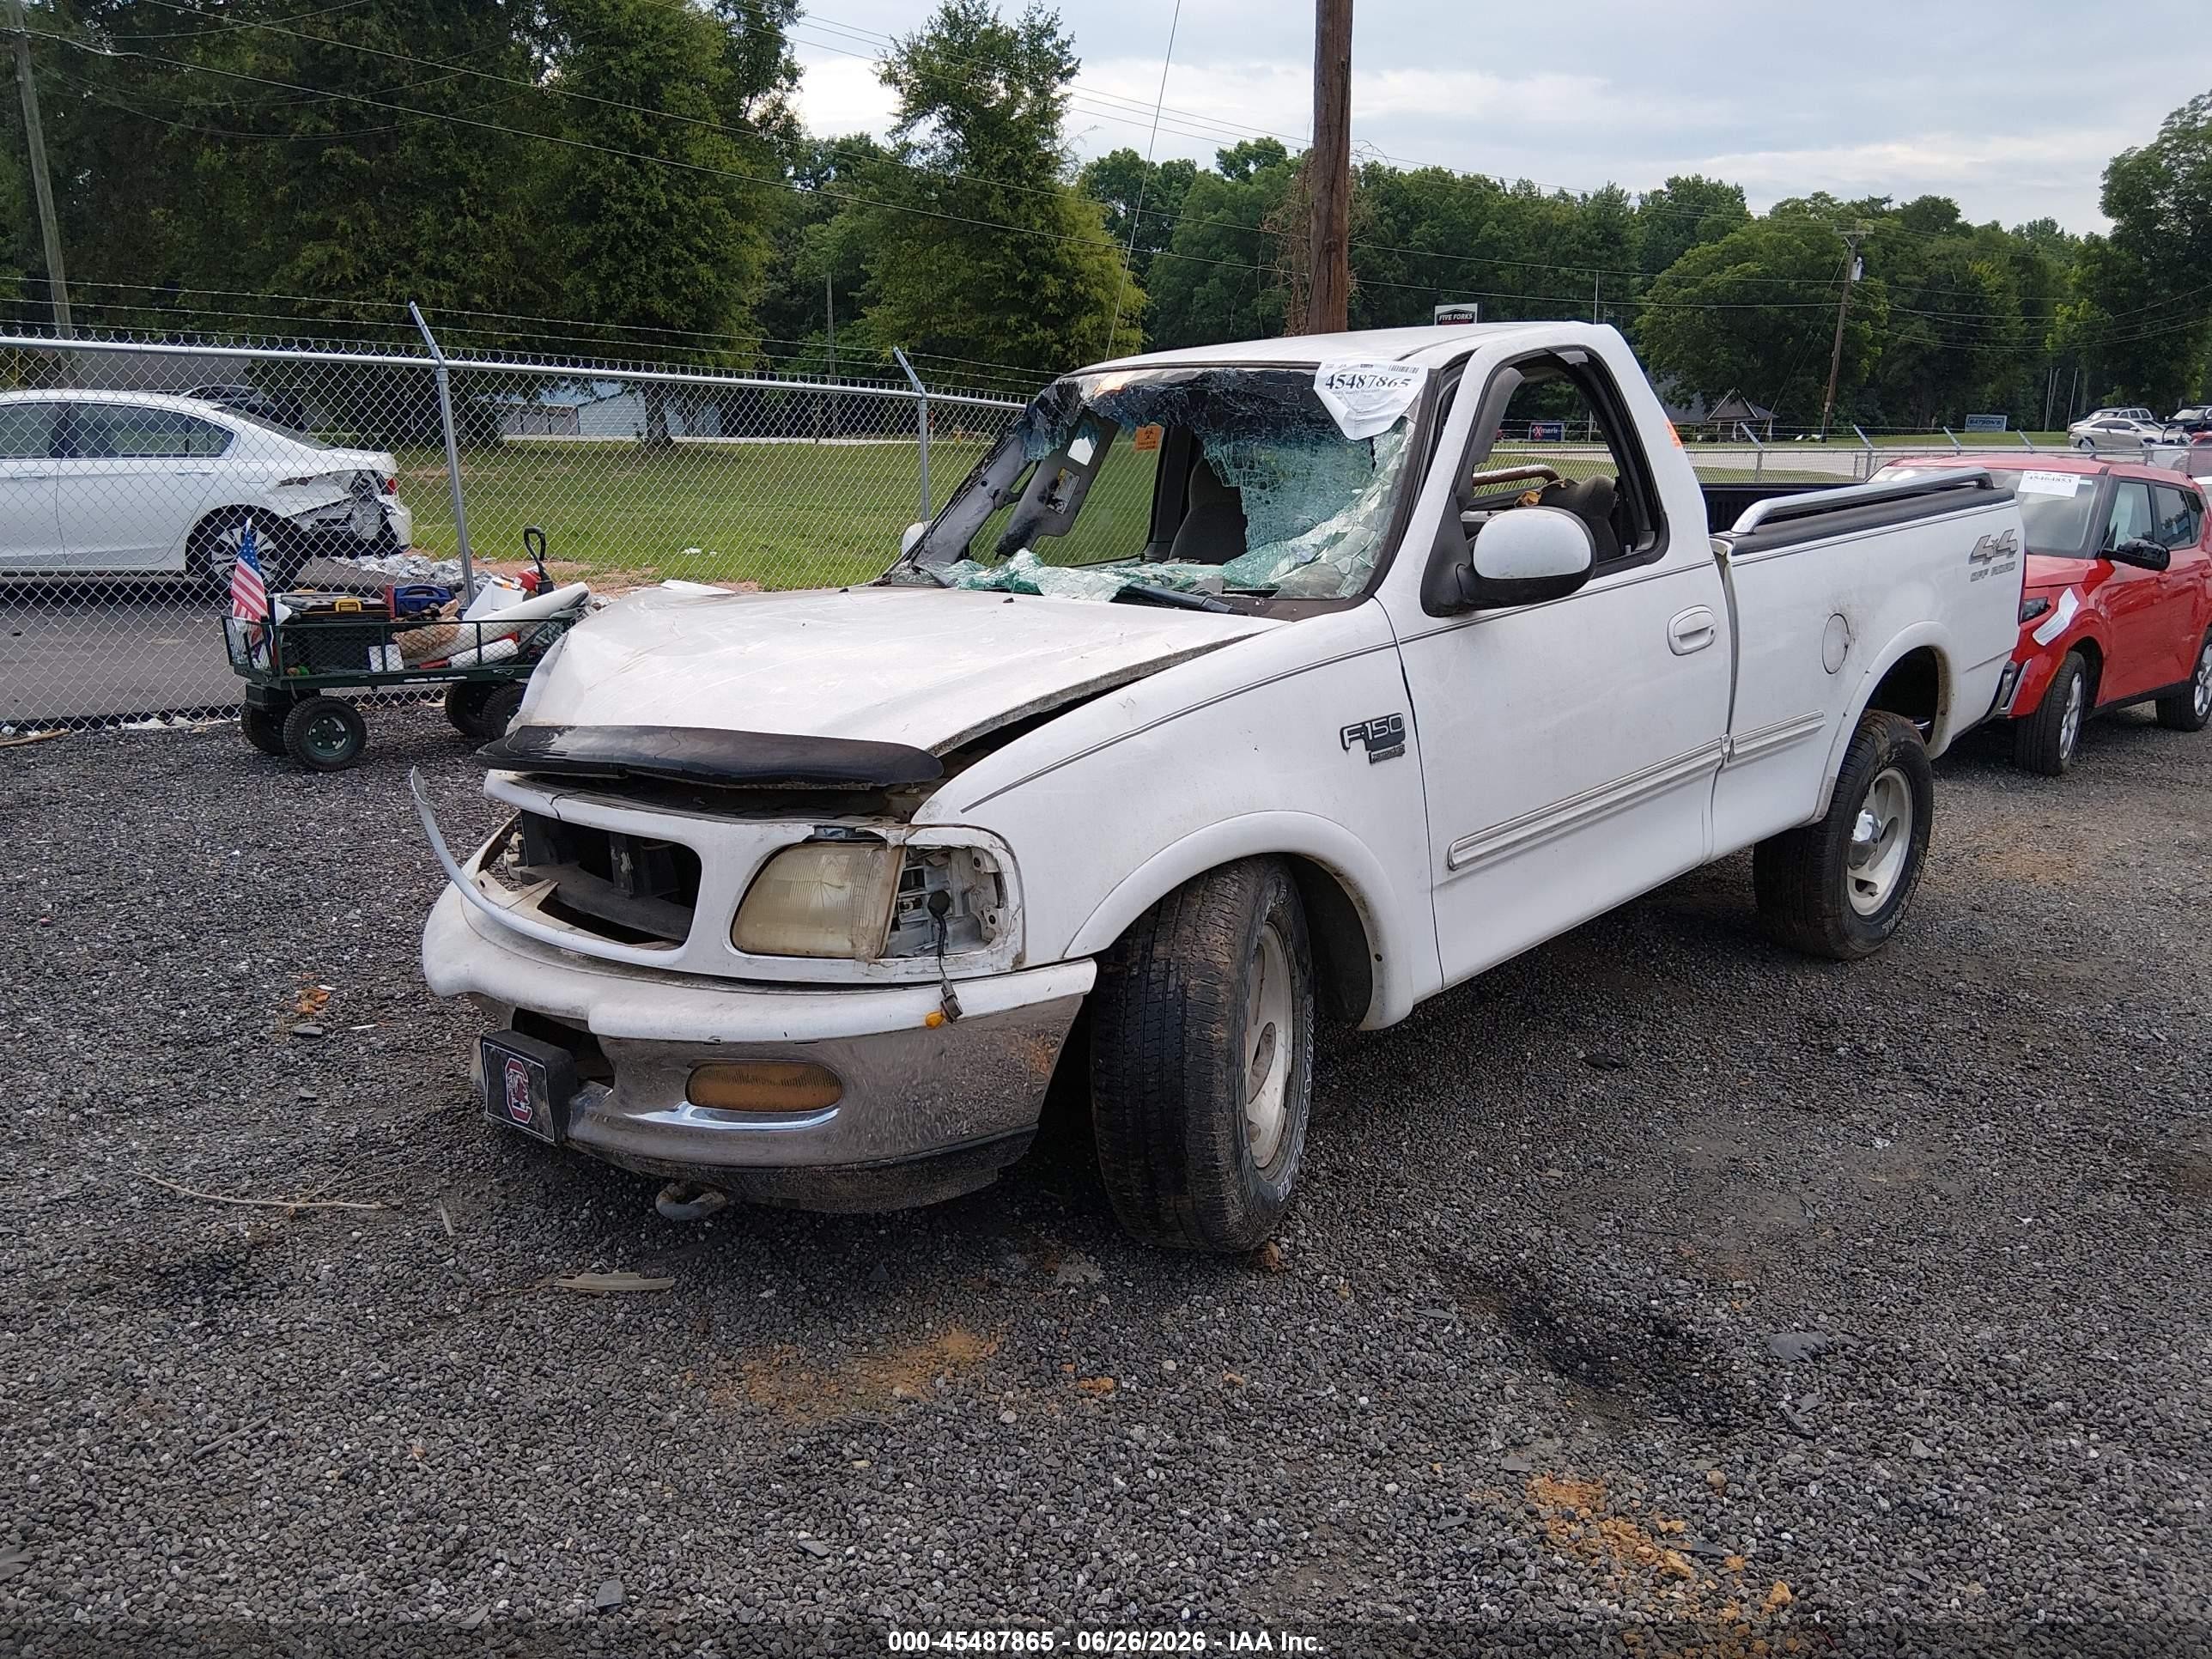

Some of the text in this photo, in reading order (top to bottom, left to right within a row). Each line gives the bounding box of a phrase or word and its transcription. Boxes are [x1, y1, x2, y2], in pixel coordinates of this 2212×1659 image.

[1438, 313, 1453, 322] FIVE
[1325, 374, 1413, 390] 45487865
[1276, 996, 1315, 1203] WRANGLER
